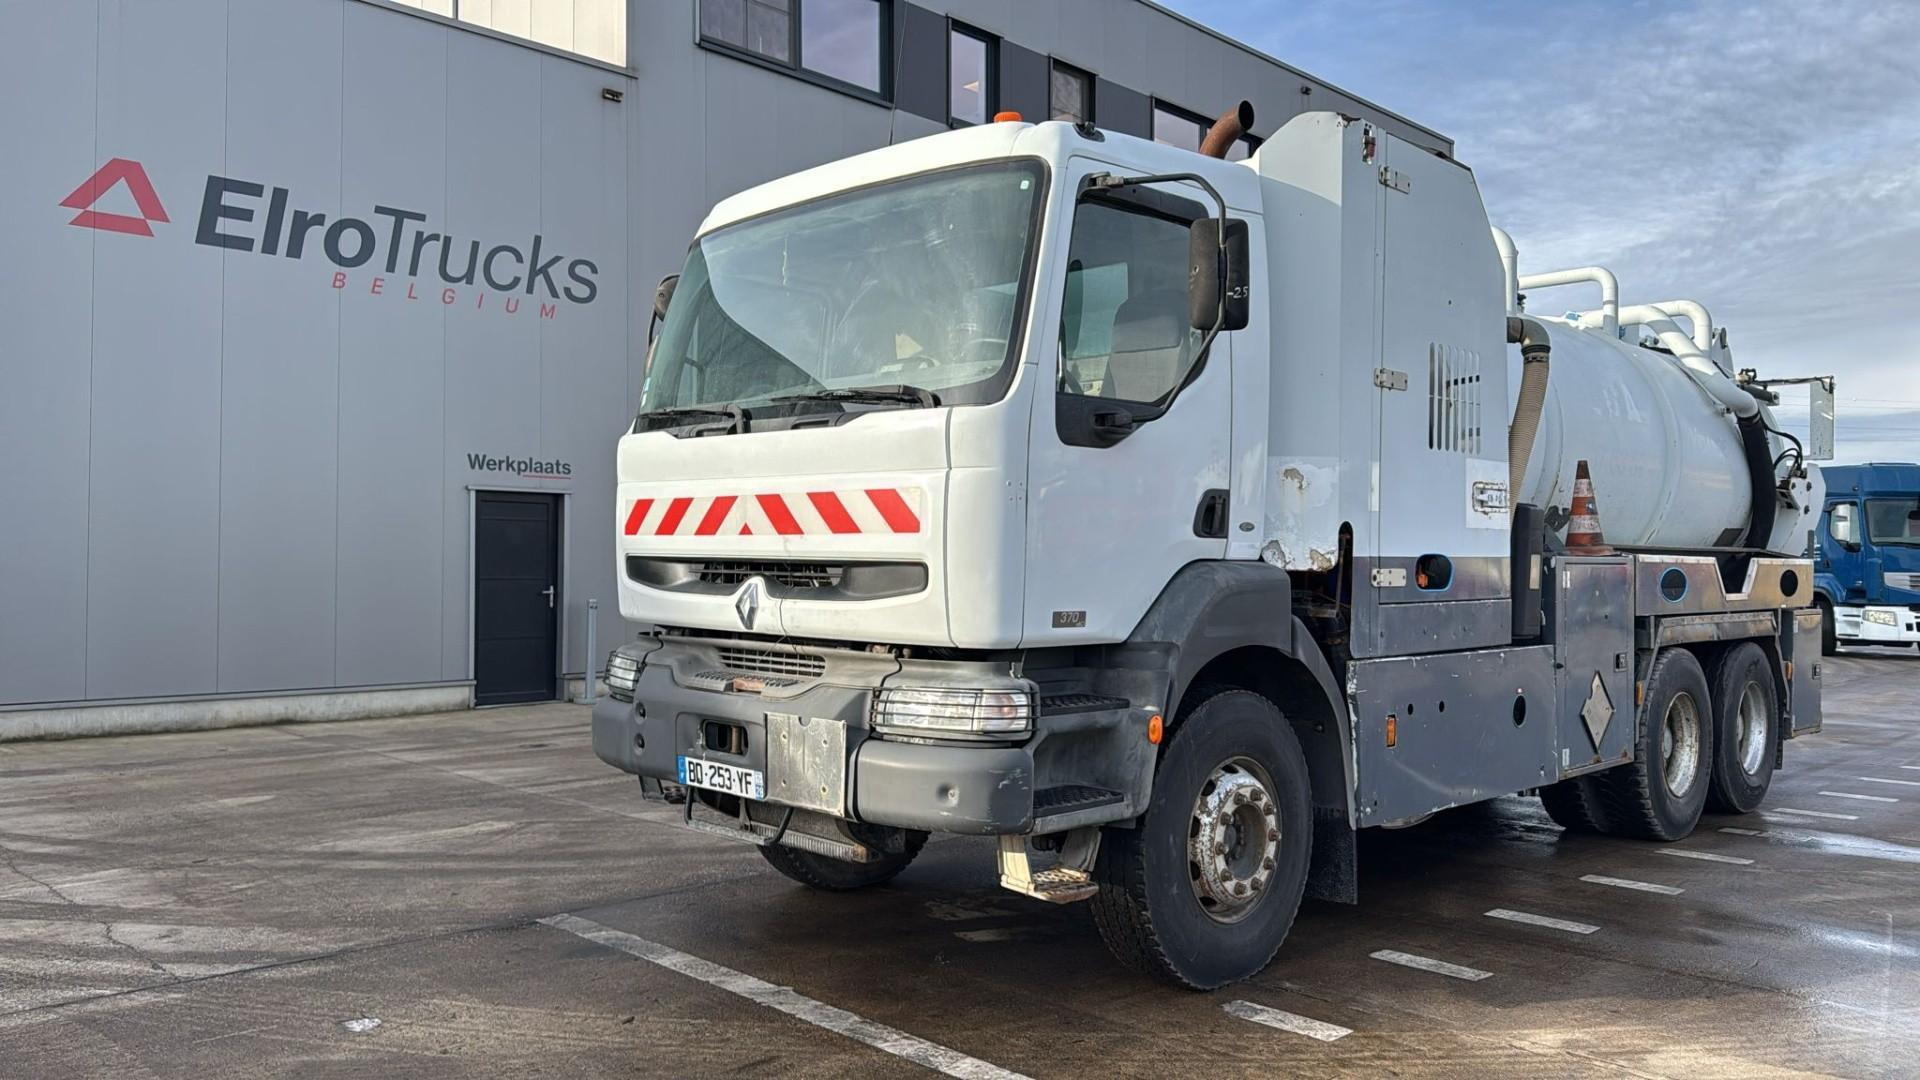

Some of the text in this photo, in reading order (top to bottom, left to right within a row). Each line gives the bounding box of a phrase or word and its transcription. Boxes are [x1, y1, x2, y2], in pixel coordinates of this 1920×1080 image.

[195, 175, 598, 304] ElroTrucks
[332, 272, 556, 320] BELGIUM
[467, 453, 572, 476] Werkplaats
[1060, 612, 1080, 624] 370
